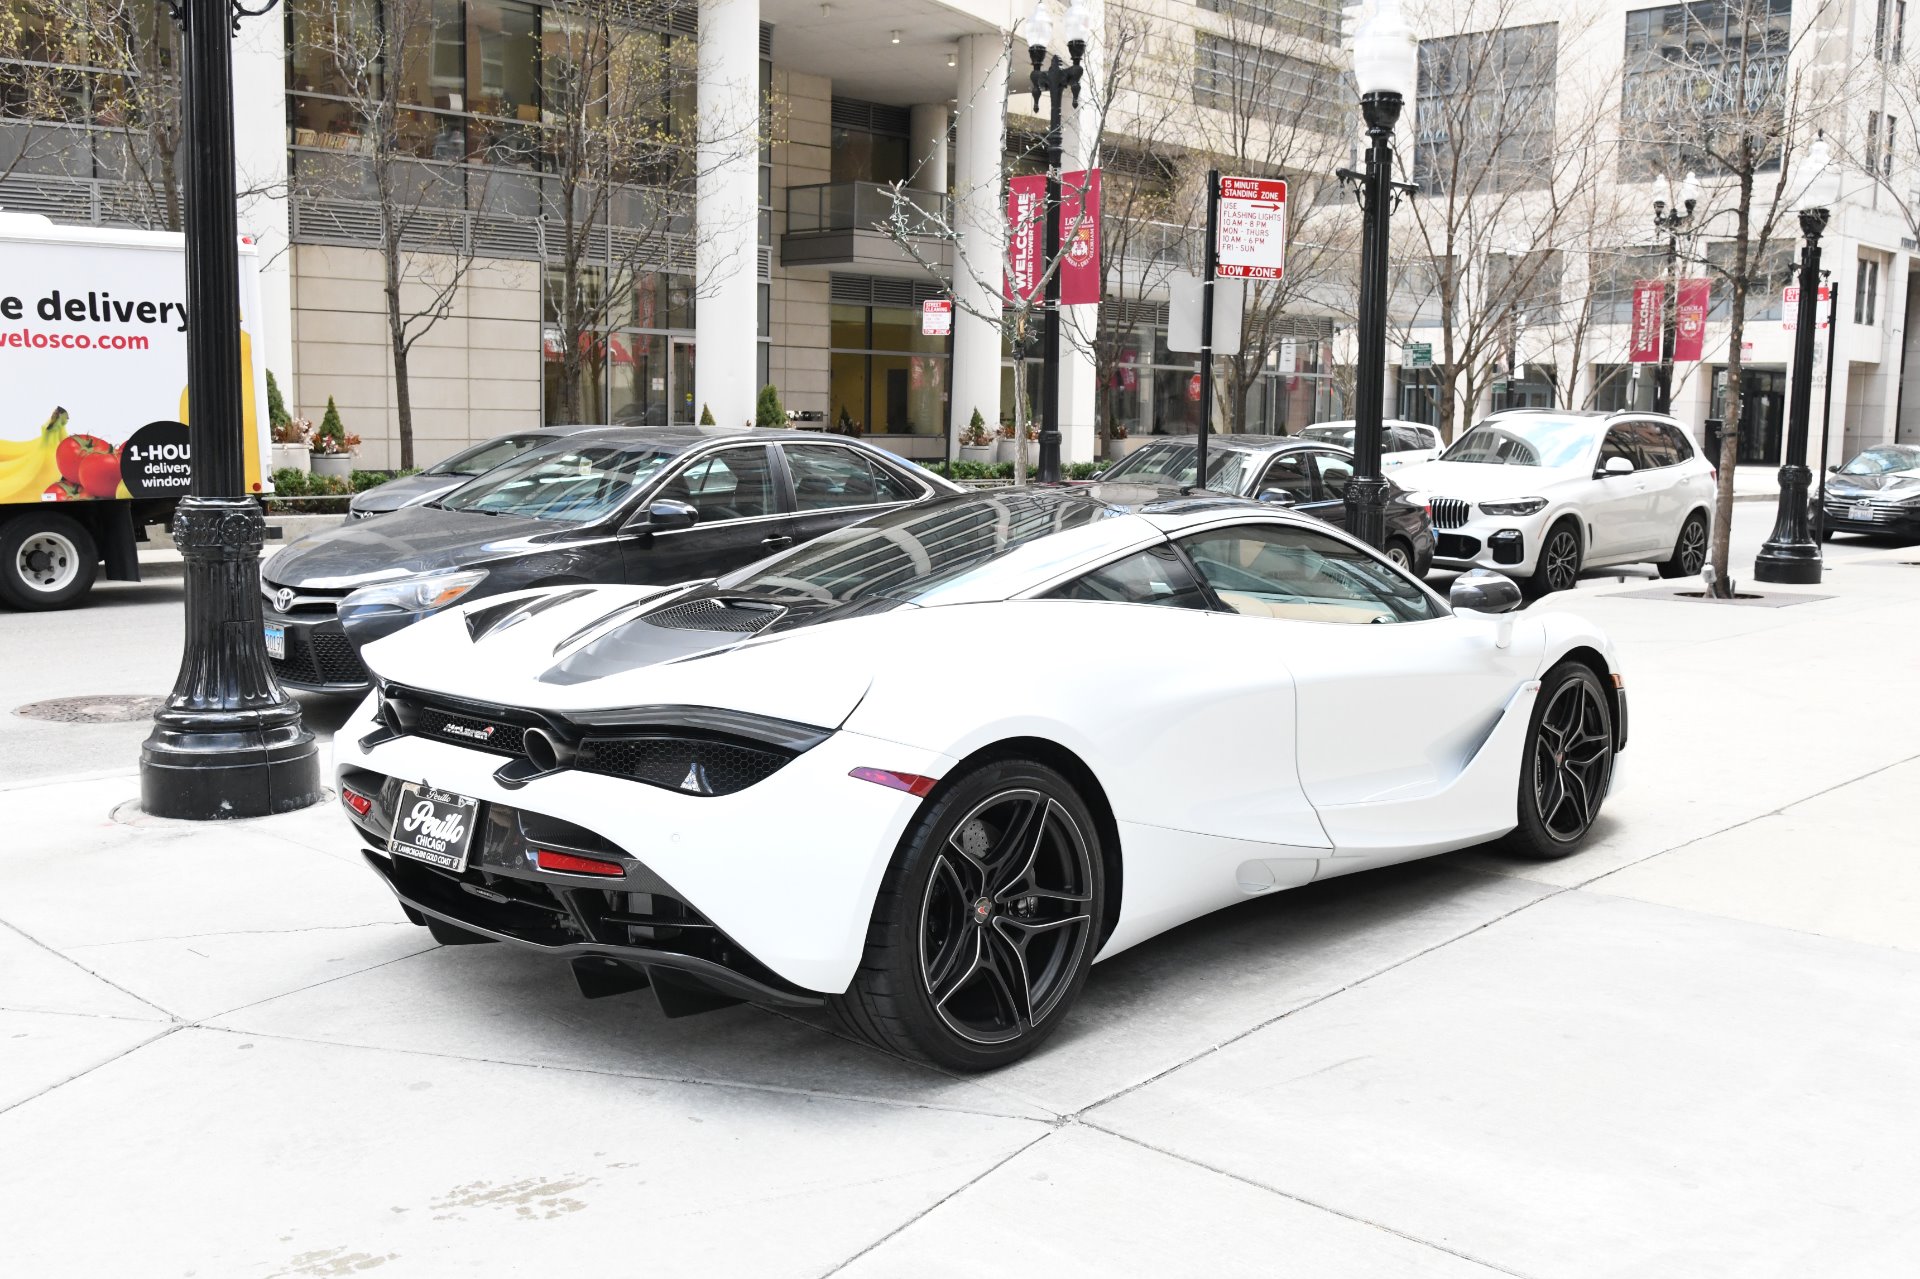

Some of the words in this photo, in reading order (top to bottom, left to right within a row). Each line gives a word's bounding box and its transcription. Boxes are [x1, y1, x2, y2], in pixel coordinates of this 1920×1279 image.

[1224, 180, 1232, 188] 15
[1234, 181, 1260, 190] MINUTE
[1224, 188, 1258, 198] STANDING
[1261, 191, 1279, 200] ZONE
[1223, 211, 1257, 220] FLASHING
[1258, 213, 1282, 221] LIGHTS
[1246, 229, 1270, 237] THURS
[1016, 193, 1030, 289] WELCOME
[1027, 229, 1035, 260] TOWER
[1222, 243, 1234, 251] FRI
[1222, 264, 1244, 276] TOW
[1248, 266, 1277, 278] ZONE
[36, 290, 187, 333] delivery
[130, 443, 191, 462] 1-HOU
[415, 834, 447, 852] CHICAGO
[425, 852, 438, 862] GOLD
[437, 855, 453, 866] COAST
